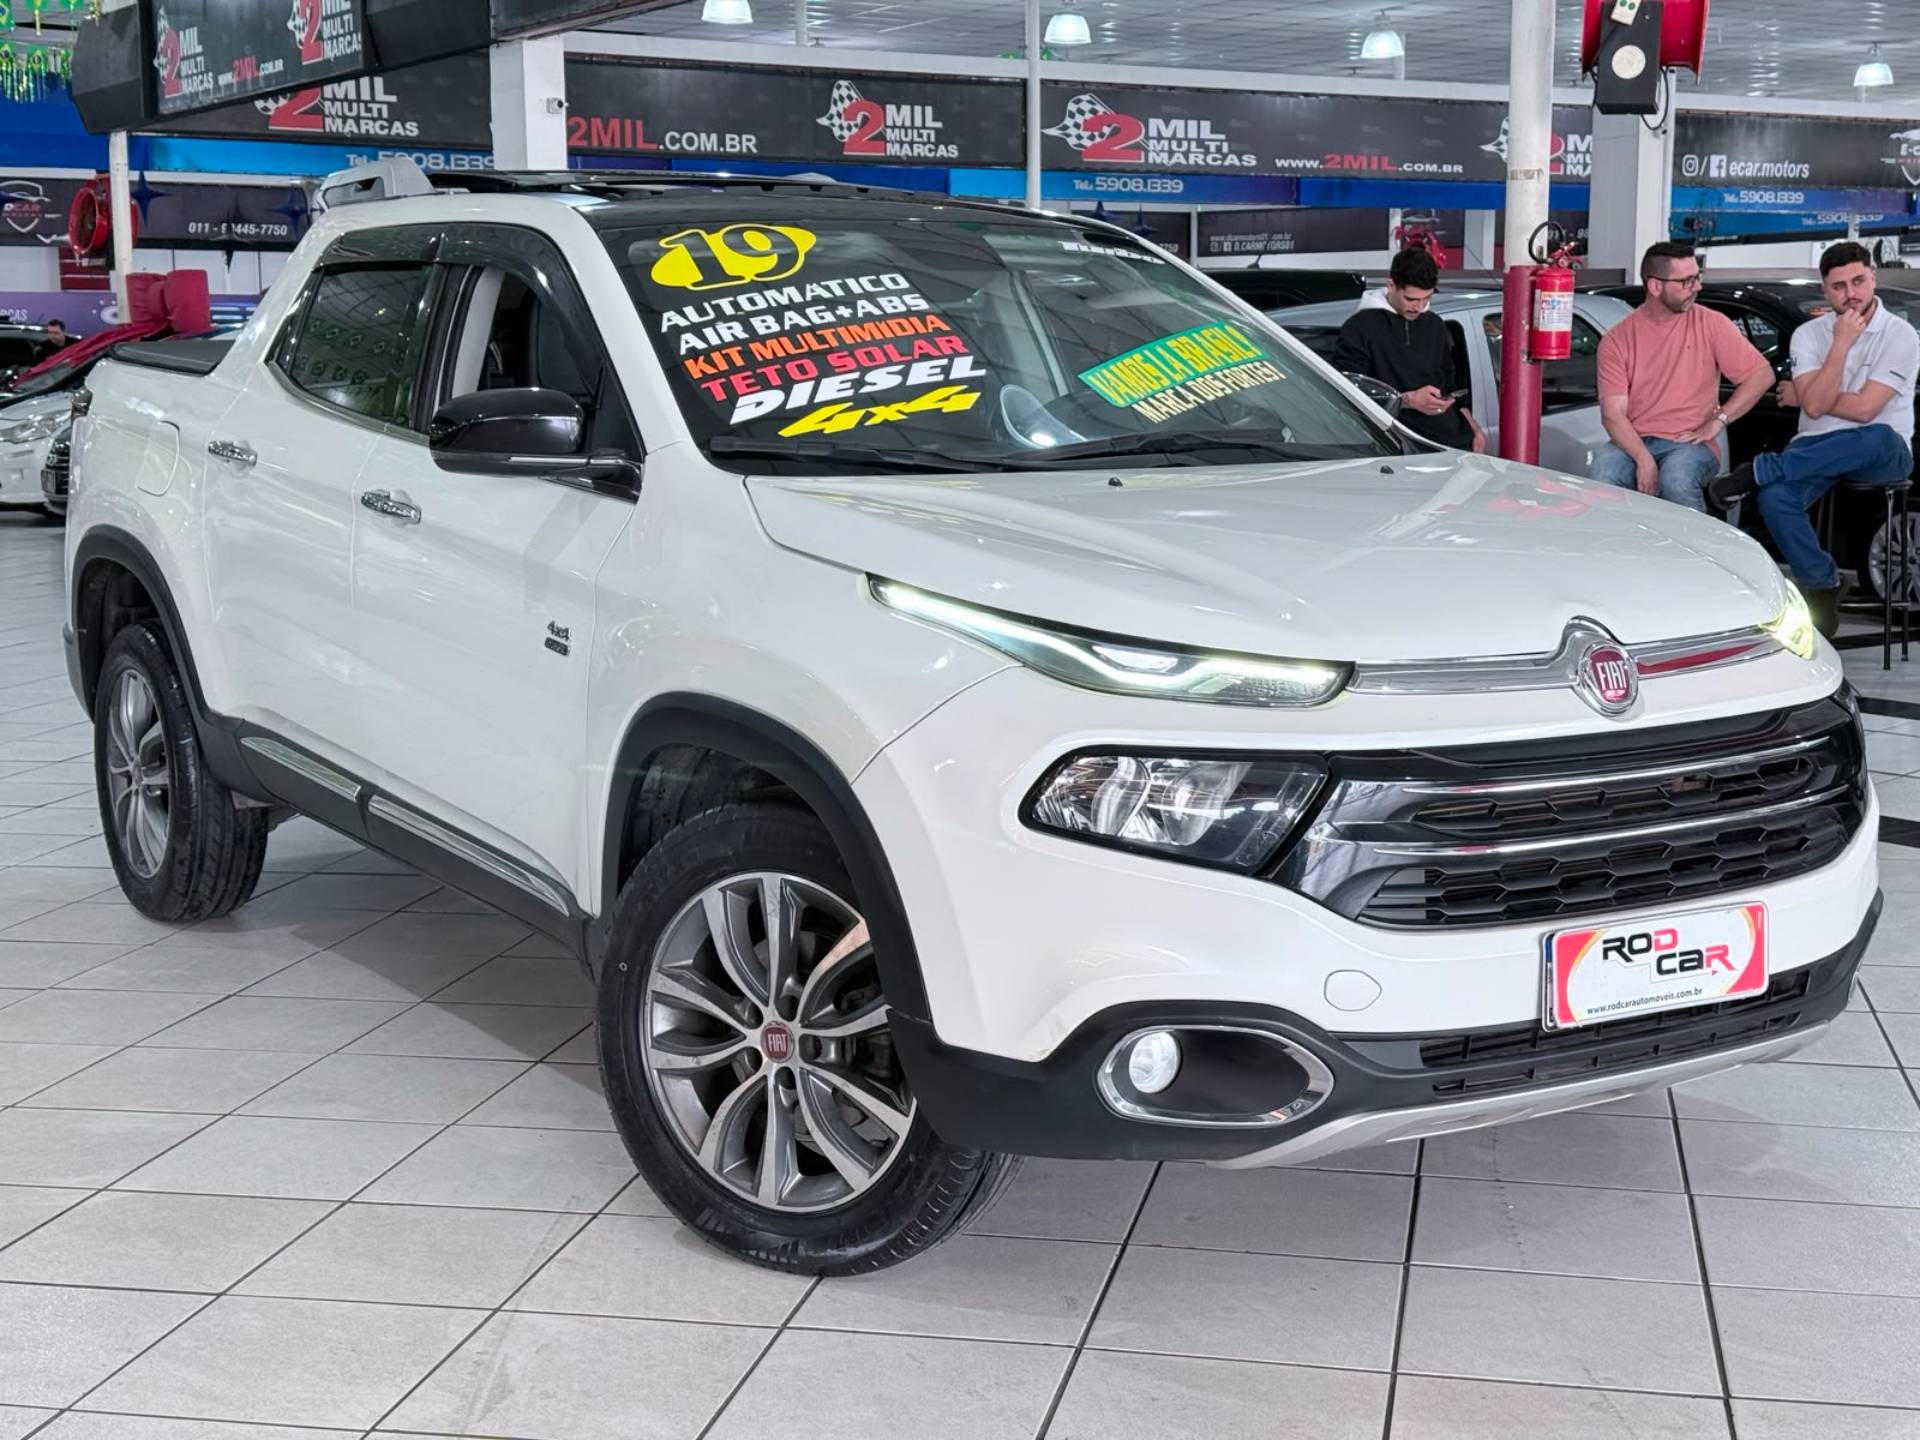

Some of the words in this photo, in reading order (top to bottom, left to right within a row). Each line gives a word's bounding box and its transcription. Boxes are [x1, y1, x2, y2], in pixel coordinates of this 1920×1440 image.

[322, 13, 353, 39] MULTI
[179, 26, 203, 57] MIL
[180, 56, 205, 77] MULTI
[181, 71, 214, 96] MARCAS
[324, 76, 398, 102] MIL
[324, 101, 388, 118] MULTI
[324, 118, 419, 137] MARCAS
[842, 98, 885, 156] 2
[885, 104, 943, 128] MIL
[885, 128, 936, 142] MULTI
[1081, 112, 1146, 163] 2
[1148, 118, 1227, 140] MIL
[885, 142, 960, 158] MARCAS
[1148, 139, 1229, 153] MULTI
[1148, 152, 1257, 167] MARCAS
[1728, 160, 1810, 179] ecar.motors
[1095, 176, 1184, 193] 5908.1339
[188, 221, 210, 234] 011
[658, 222, 806, 291] 19
[679, 320, 748, 355] AIR
[750, 292, 930, 336] BAG+ABS
[684, 346, 746, 380] KIT
[701, 358, 819, 402] TETO
[826, 334, 969, 373] SOLAR
[729, 355, 987, 425] DIESEL
[1087, 352, 1171, 406] VAMOS
[777, 384, 982, 438] 4x4
[1131, 385, 1206, 424] MARCA
[1185, 373, 1233, 402] DOS
[1595, 660, 1628, 692] FIAT
[1602, 928, 1679, 963] ROD
[1586, 986, 1703, 1015] www.rodcarautomoveis.com.br
[767, 1033, 788, 1052] FIAT
